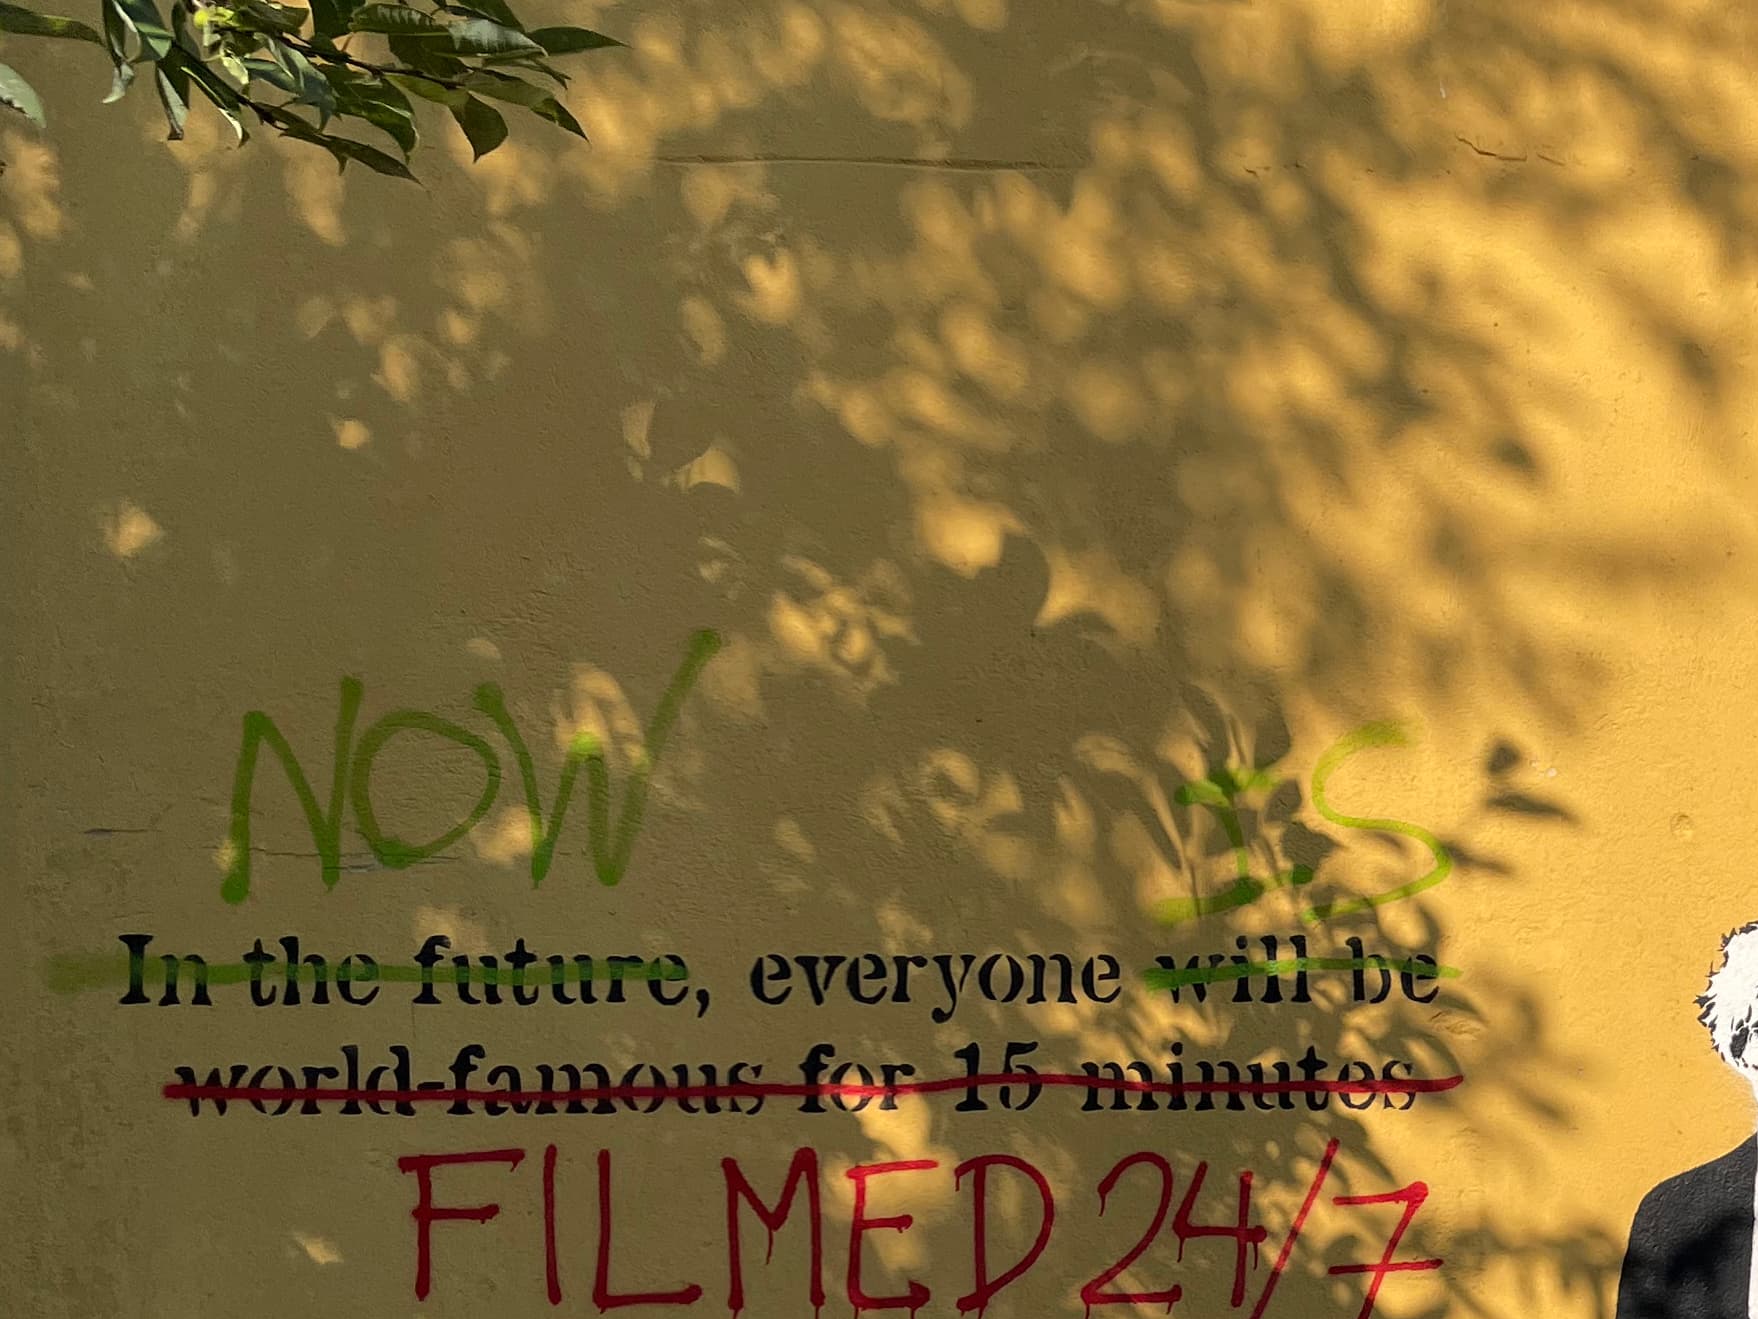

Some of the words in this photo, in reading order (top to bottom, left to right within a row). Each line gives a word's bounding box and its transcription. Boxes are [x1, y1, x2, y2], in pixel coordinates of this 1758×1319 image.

[221, 628, 722, 904] NOW
[118, 933, 212, 1006] In
[242, 936, 381, 1006] the
[412, 935, 710, 1018] future,
[749, 952, 1122, 1024] everyone
[1154, 934, 1312, 1004] will
[1346, 935, 1440, 1004] be
[174, 1043, 765, 1117] world-famous
[798, 1043, 916, 1115] for
[954, 1042, 1040, 1113] 15
[1081, 1041, 1417, 1112] minutes
